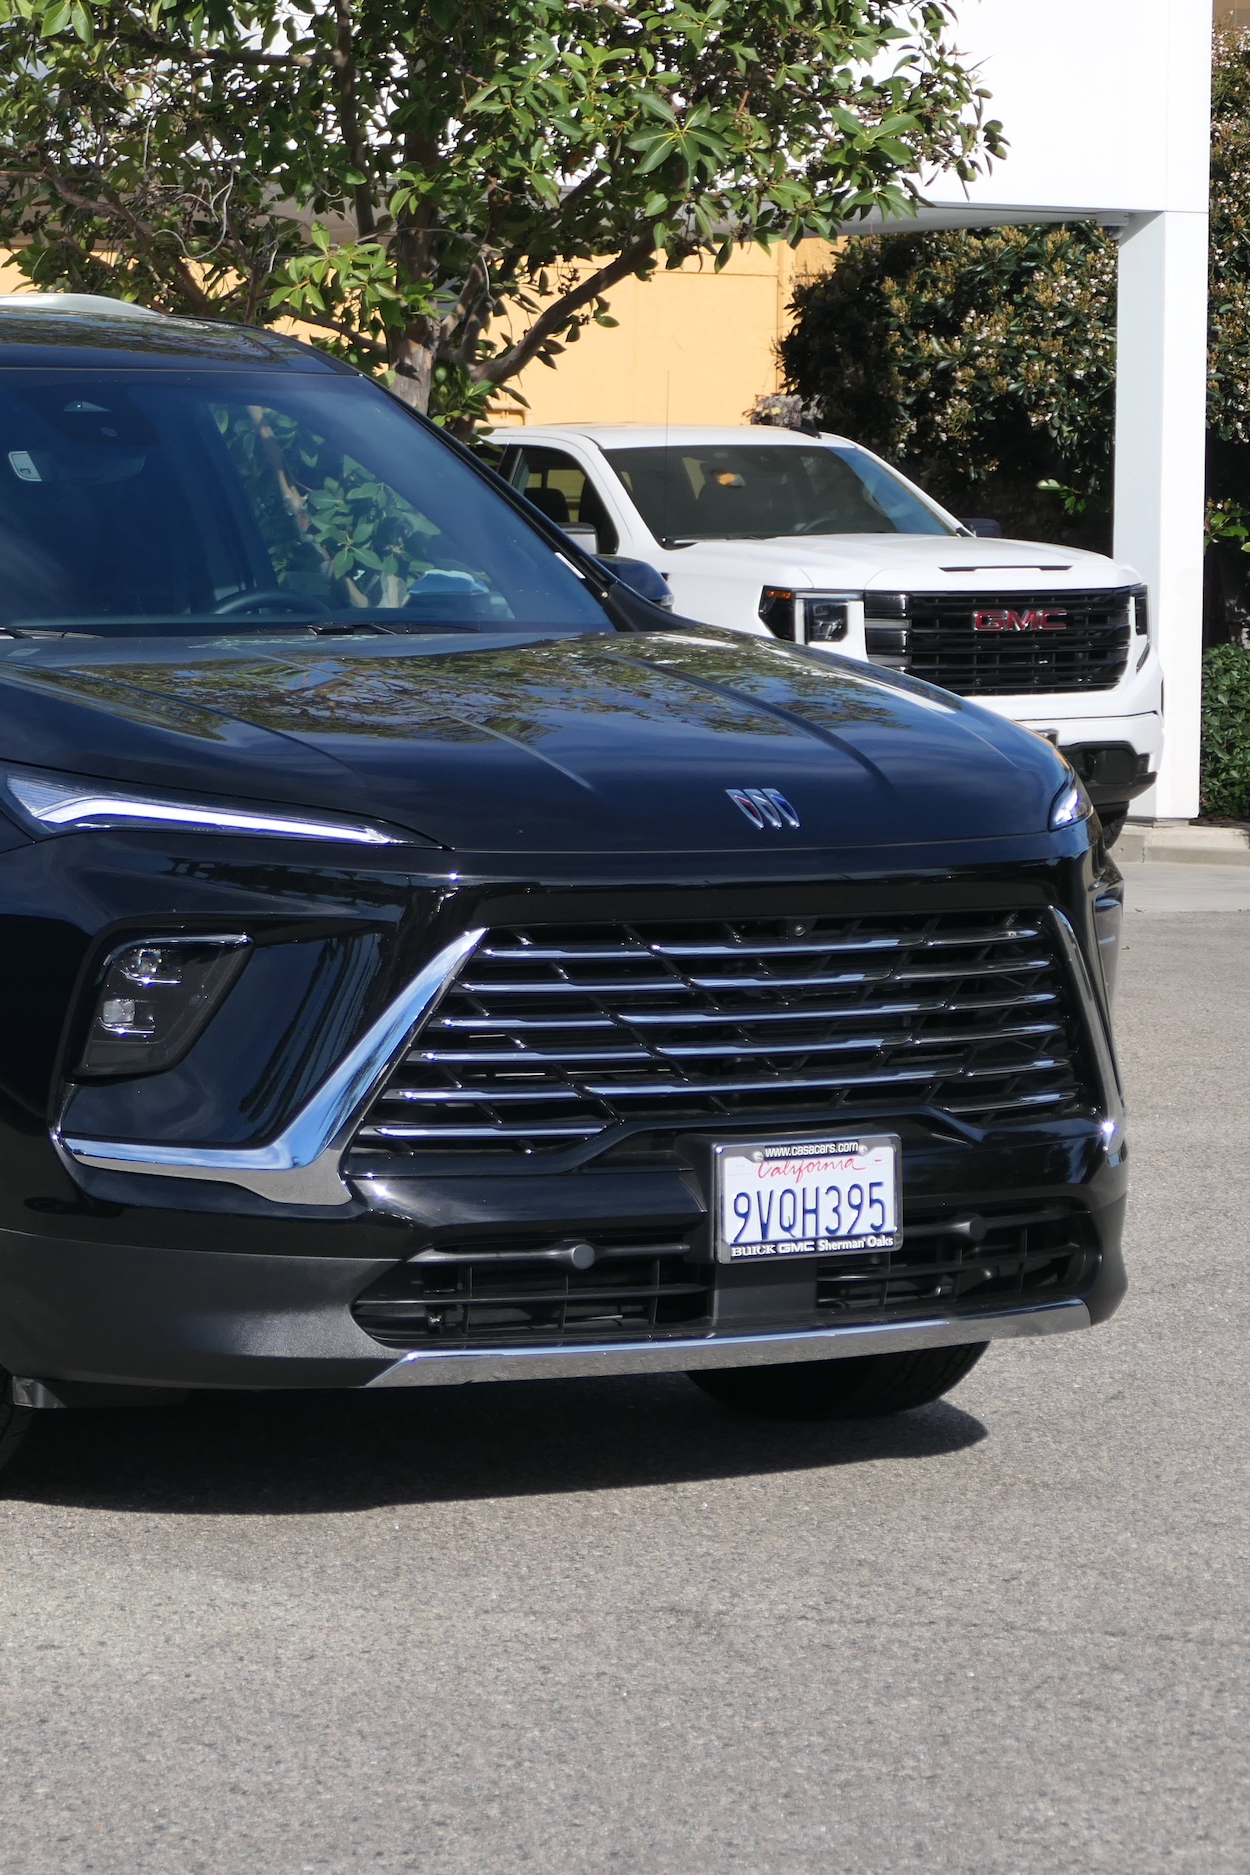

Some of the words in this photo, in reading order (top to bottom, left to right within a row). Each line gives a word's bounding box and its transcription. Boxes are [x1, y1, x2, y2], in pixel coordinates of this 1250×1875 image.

[972, 609, 1067, 631] GMC
[764, 1141, 859, 1158] www.casacars.com
[757, 1156, 866, 1184] California
[733, 1181, 886, 1243] 9VQH395
[731, 1244, 776, 1257] BUICK
[778, 1241, 815, 1254] GMC
[817, 1239, 865, 1252] Sherman
[867, 1235, 894, 1248] Oaks
